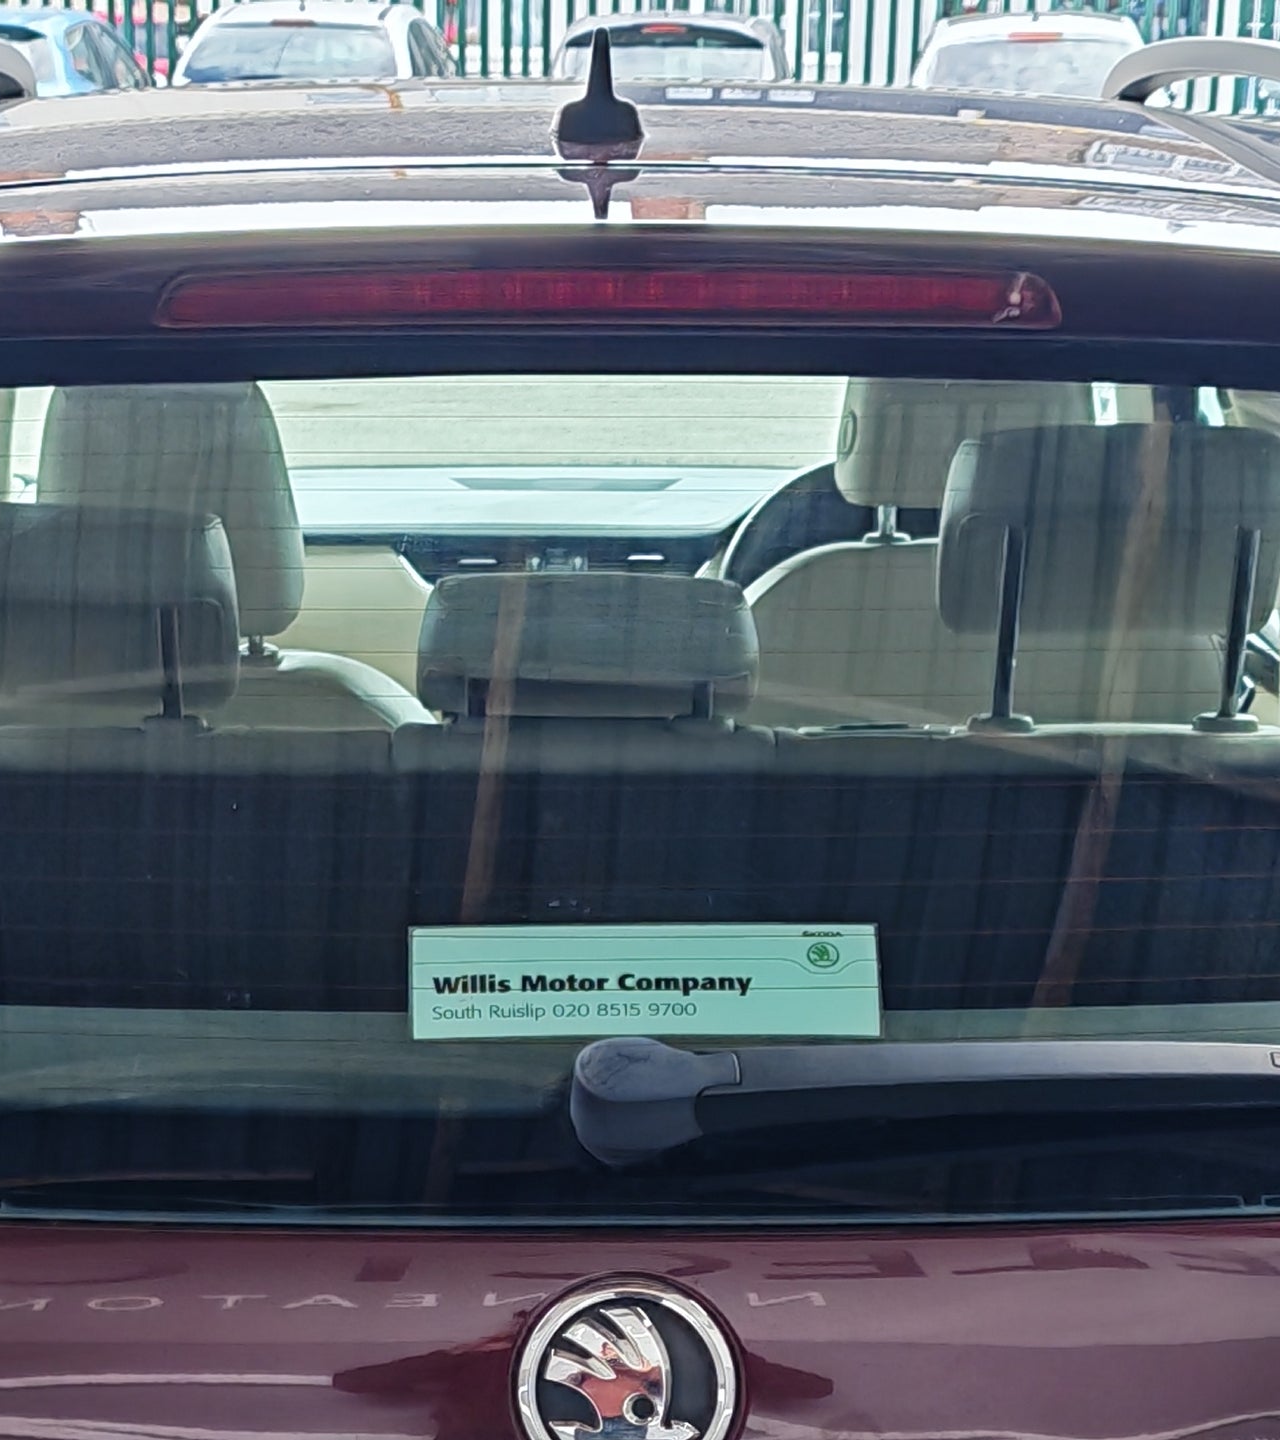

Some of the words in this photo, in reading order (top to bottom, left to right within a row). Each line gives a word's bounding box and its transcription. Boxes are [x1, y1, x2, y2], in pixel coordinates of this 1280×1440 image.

[432, 974, 511, 994] Willis
[521, 974, 610, 993] Motor
[617, 973, 753, 997] Company
[432, 1003, 482, 1020] South
[489, 1002, 546, 1022] Ruislip
[552, 1003, 590, 1018] 020
[597, 1002, 641, 1017] 8515
[648, 1002, 697, 1017] 9700
